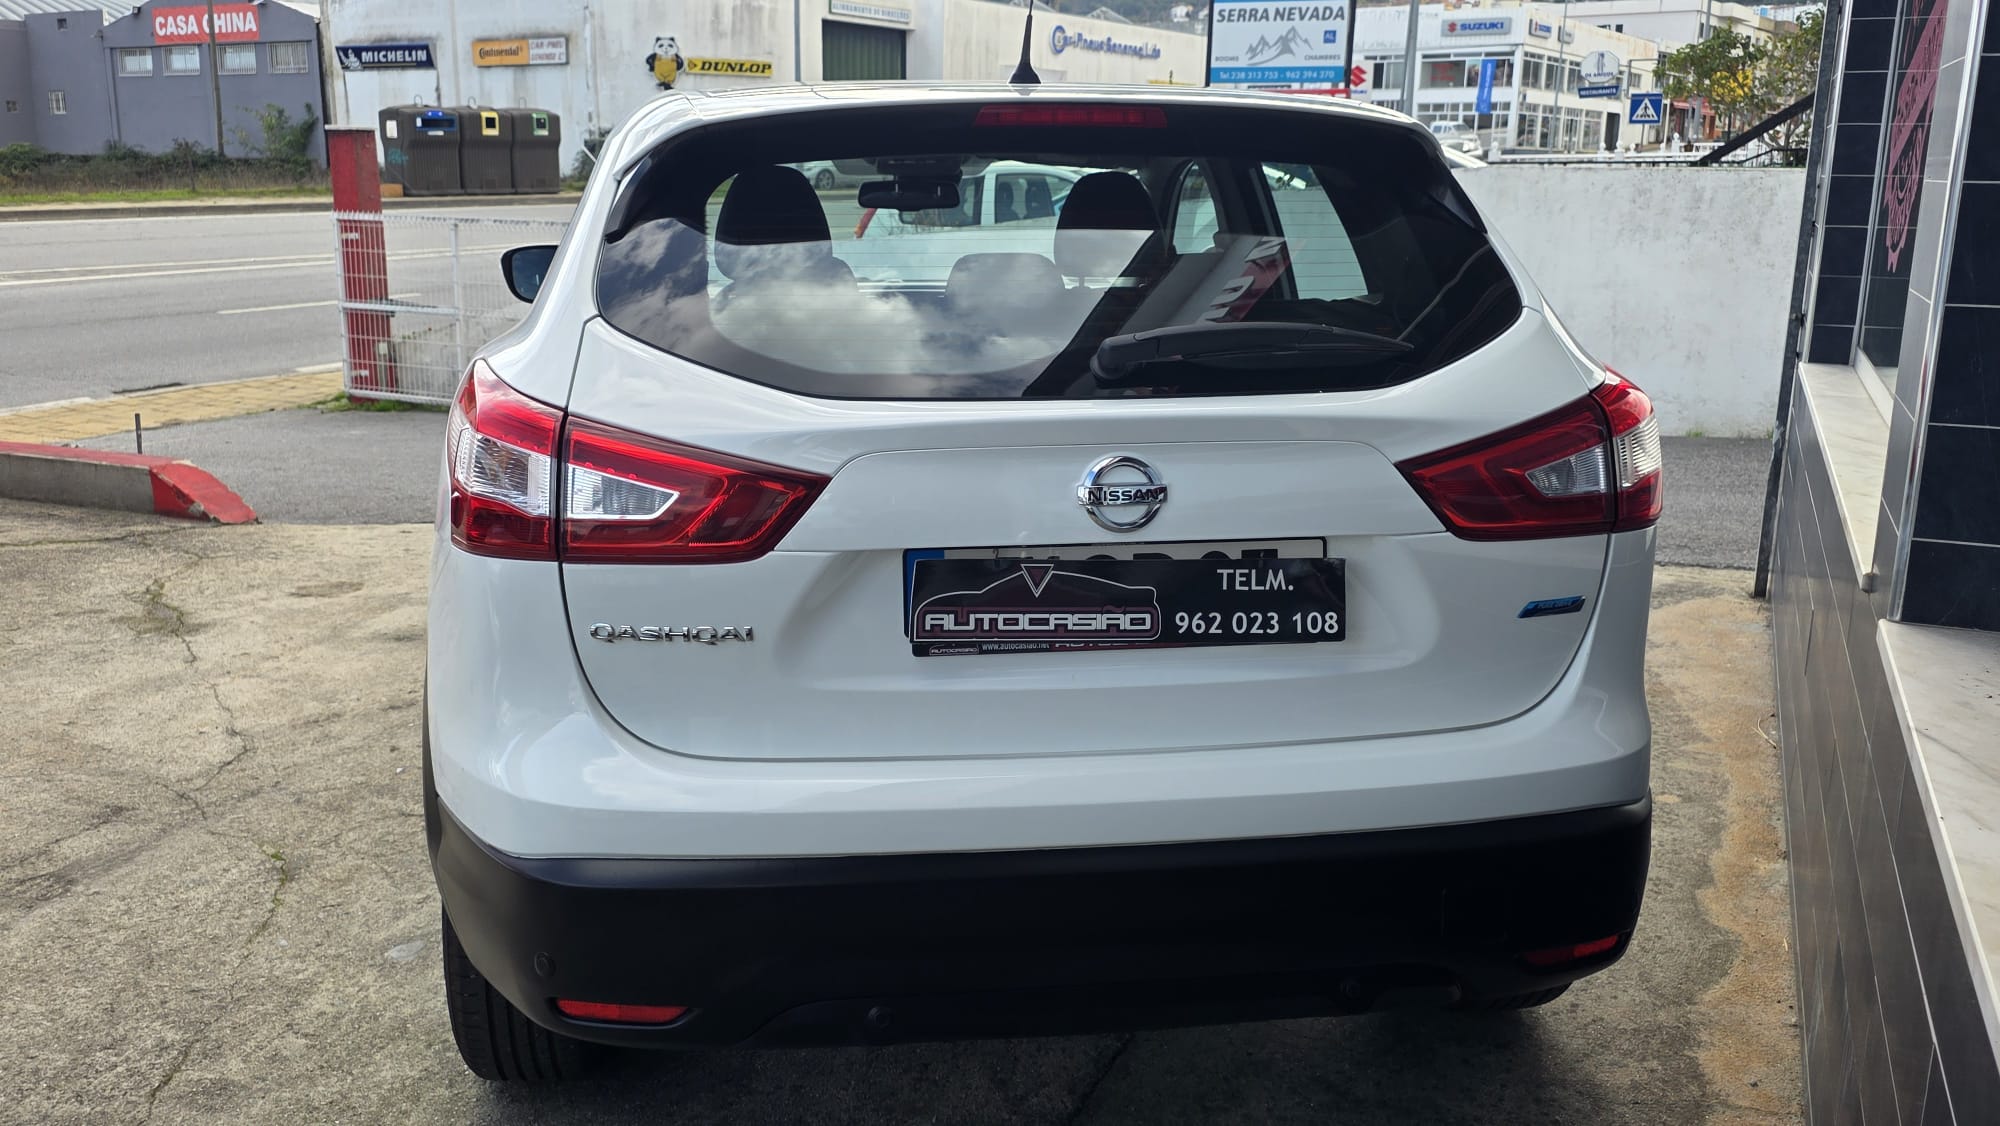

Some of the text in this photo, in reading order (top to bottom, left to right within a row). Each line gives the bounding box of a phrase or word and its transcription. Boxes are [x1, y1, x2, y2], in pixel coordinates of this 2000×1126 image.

[155, 11, 257, 36] CASA CHINA
[1216, 8, 1270, 23] SERRA
[1273, 6, 1346, 22] NEVADA
[1460, 22, 1505, 32] SUZUKI
[361, 49, 427, 63] MICHELIN
[700, 61, 772, 74] DUNLOP
[1088, 487, 1162, 502] NISSAN
[1216, 569, 1294, 591] TELM.
[924, 605, 1152, 632] AUTOCASIÃO
[1175, 612, 1339, 634] 962 023 108
[589, 622, 755, 645] QASHQAI
